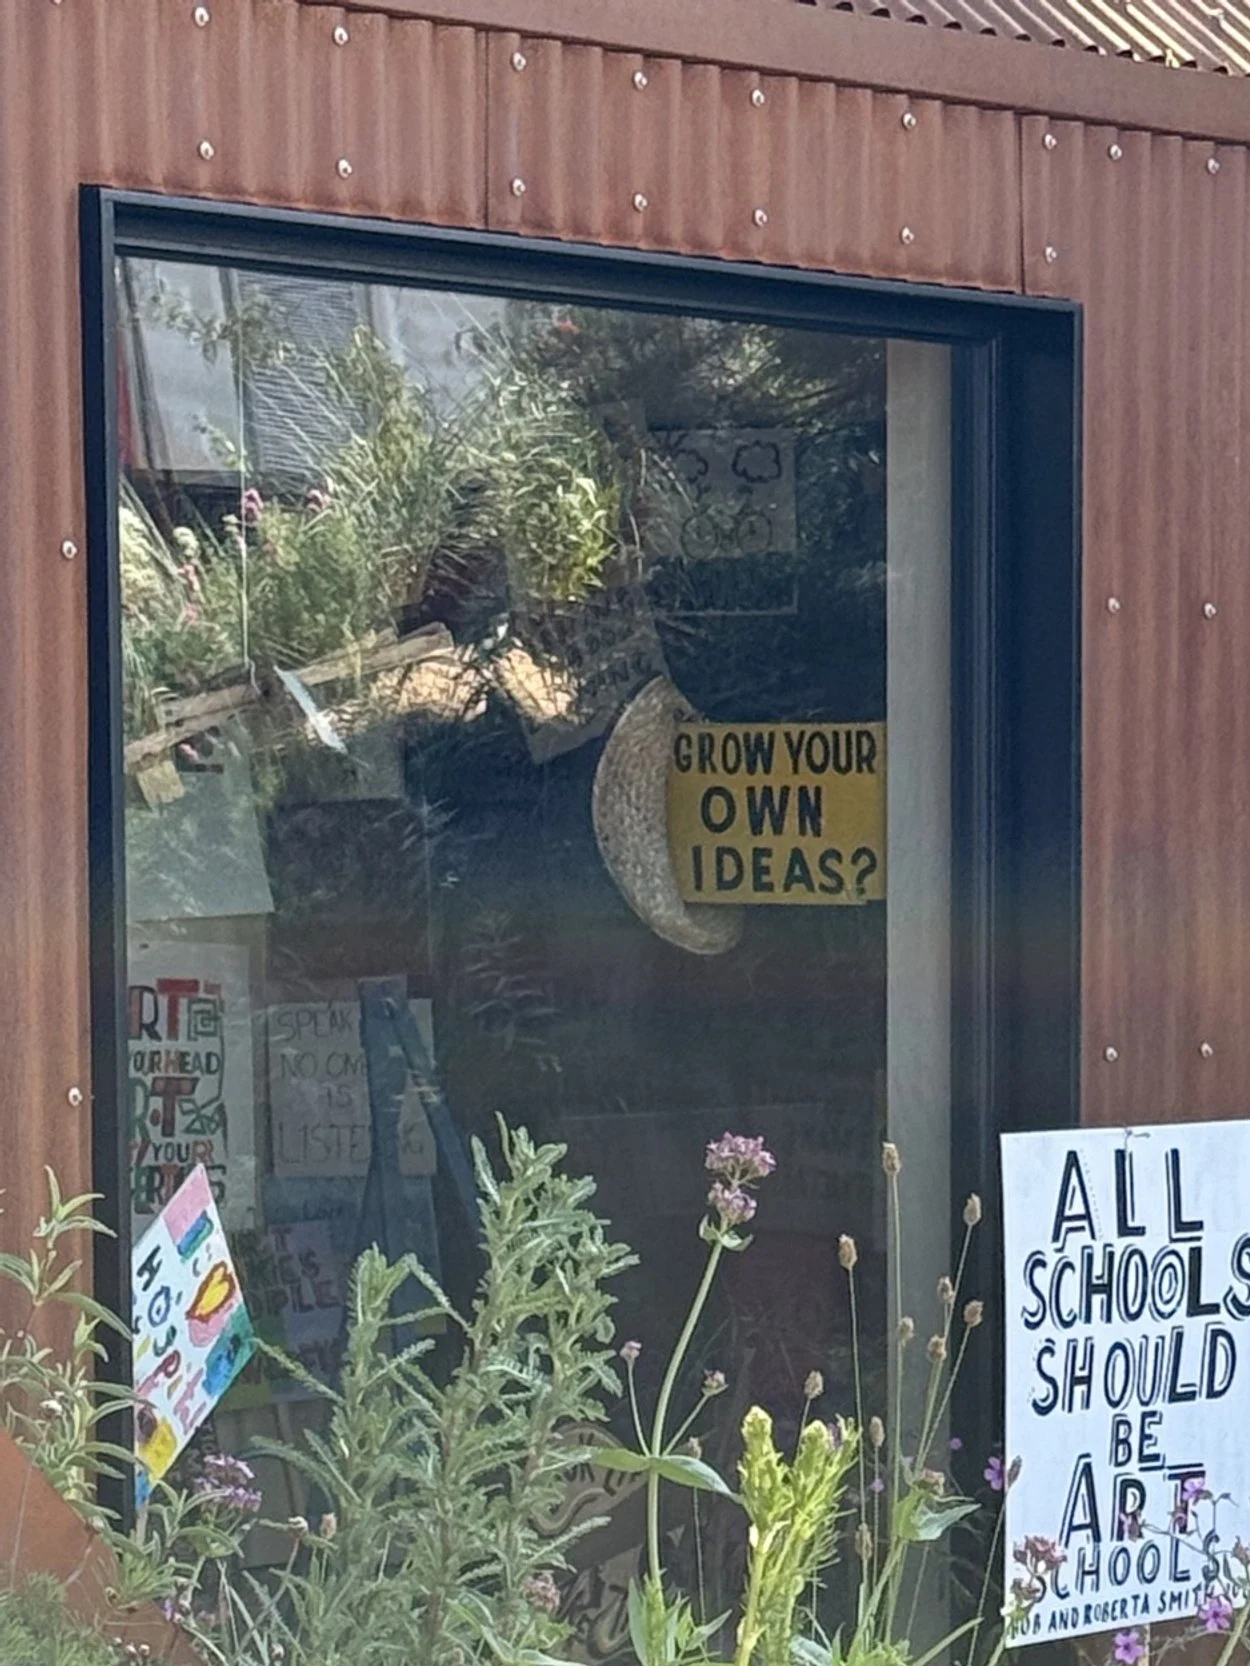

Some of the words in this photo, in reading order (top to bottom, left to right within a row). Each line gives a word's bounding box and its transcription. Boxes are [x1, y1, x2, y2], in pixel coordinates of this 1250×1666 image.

[674, 730, 776, 775] GROW
[784, 729, 877, 775] YOUR
[701, 784, 822, 837] OWN
[692, 846, 877, 896] IDEAS?
[326, 1051, 367, 1079] ON
[1052, 1148, 1204, 1253] ALL
[1030, 1321, 1237, 1416] SHOULD
[1109, 1410, 1167, 1472] BE
[1058, 1453, 1206, 1548] ART
[1049, 1606, 1079, 1634] AND
[1083, 1592, 1150, 1626] ROBERTA
